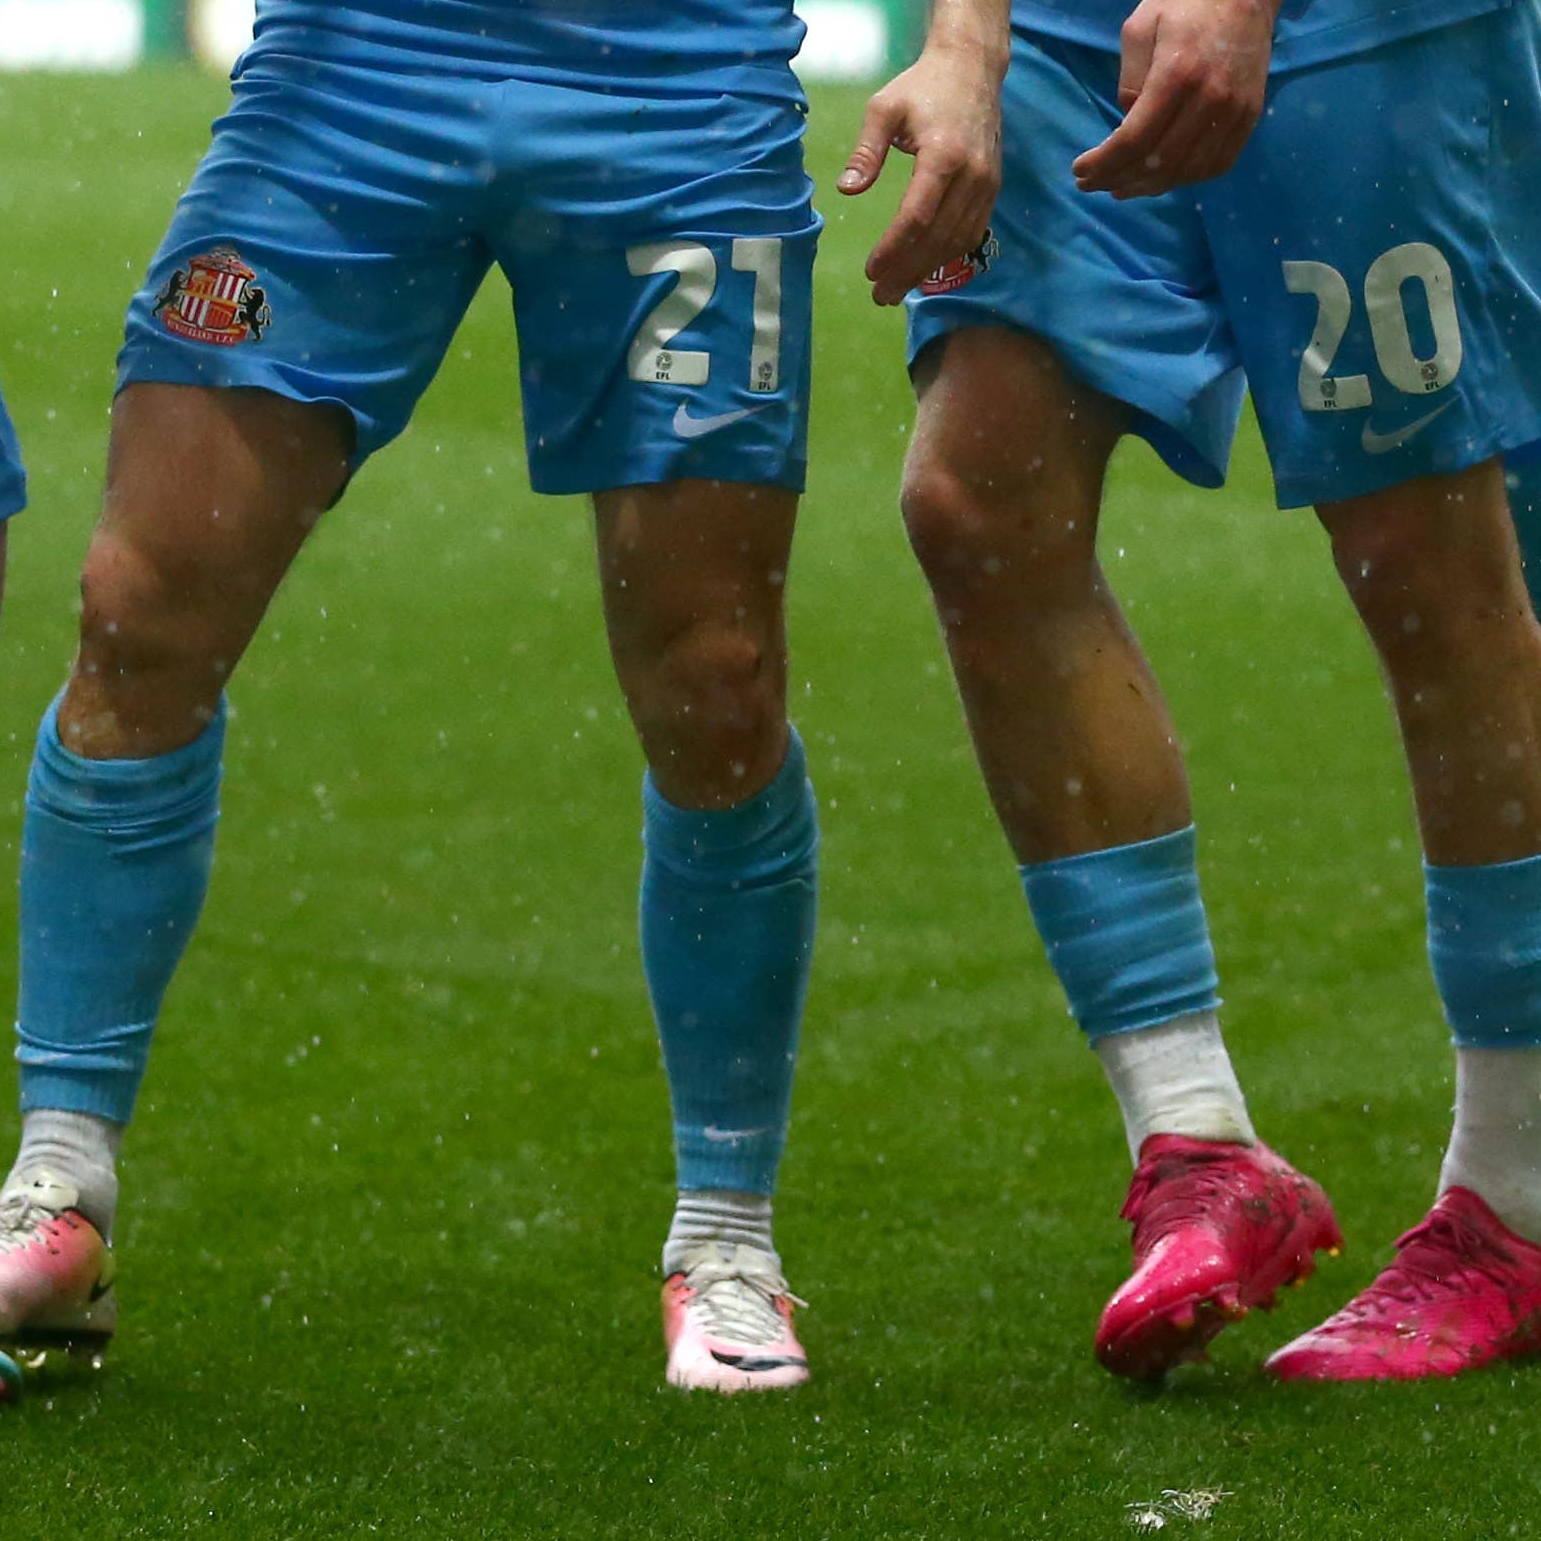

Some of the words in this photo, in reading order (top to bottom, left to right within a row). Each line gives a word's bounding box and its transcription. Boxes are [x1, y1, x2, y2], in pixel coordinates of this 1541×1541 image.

[625, 238, 783, 393] 21
[1281, 242, 1463, 412] 20
[656, 372, 671, 380] EFL
[1425, 381, 1440, 391] EFL
[1324, 400, 1337, 408] EFL
